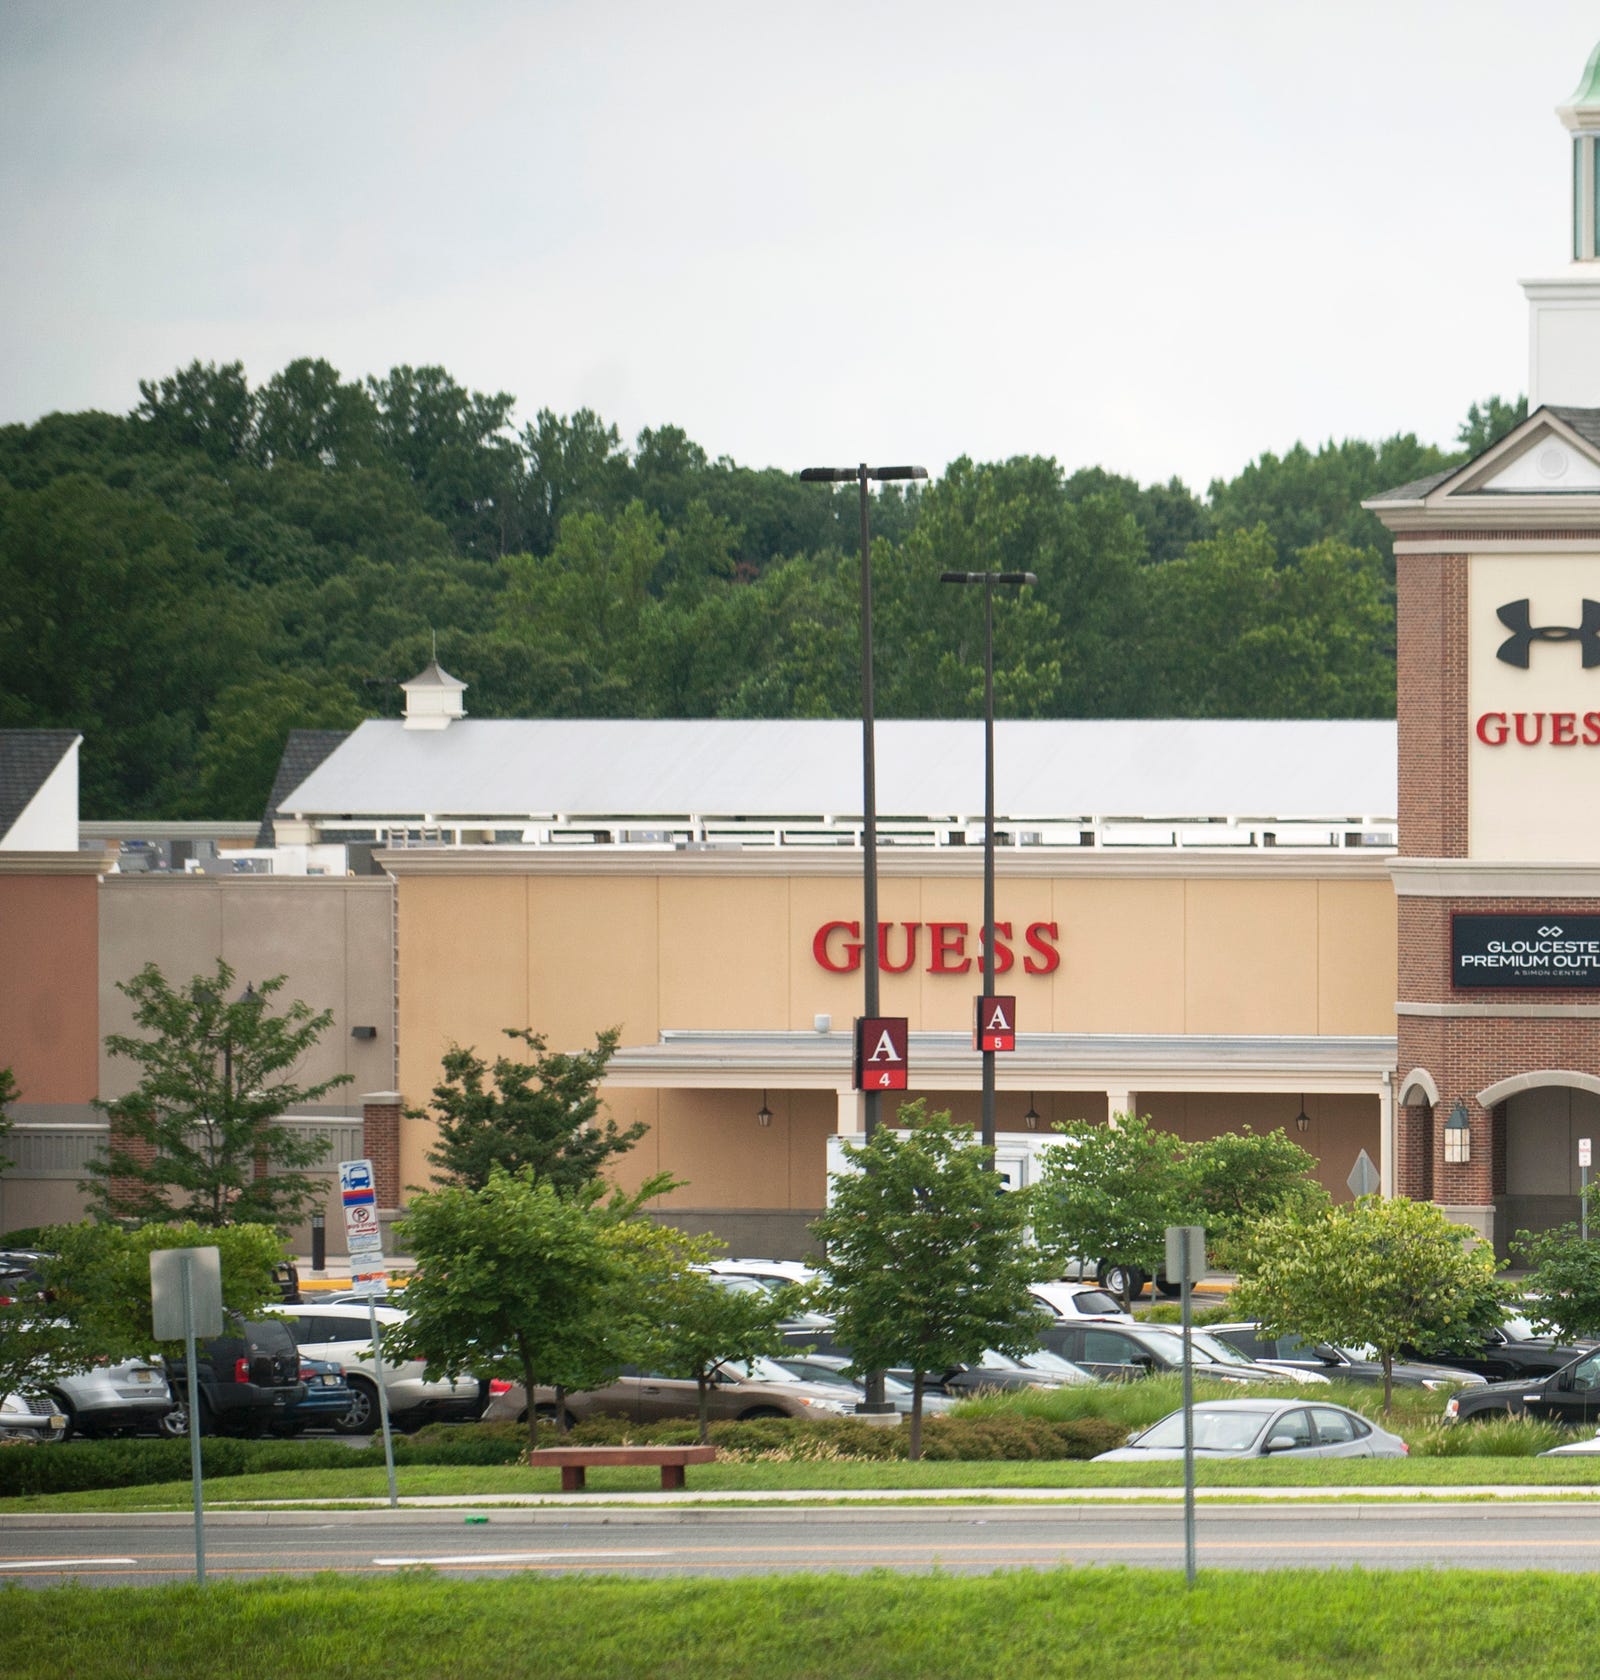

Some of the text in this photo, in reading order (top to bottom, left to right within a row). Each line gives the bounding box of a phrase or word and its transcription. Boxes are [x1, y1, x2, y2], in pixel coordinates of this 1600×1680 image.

[812, 920, 1060, 975] GUESS
[1461, 955, 1549, 968] PREMIUM
[986, 1004, 1011, 1030] A
[867, 1029, 902, 1062] A
[994, 1037, 1002, 1049] 5
[879, 1073, 891, 1087] 4
